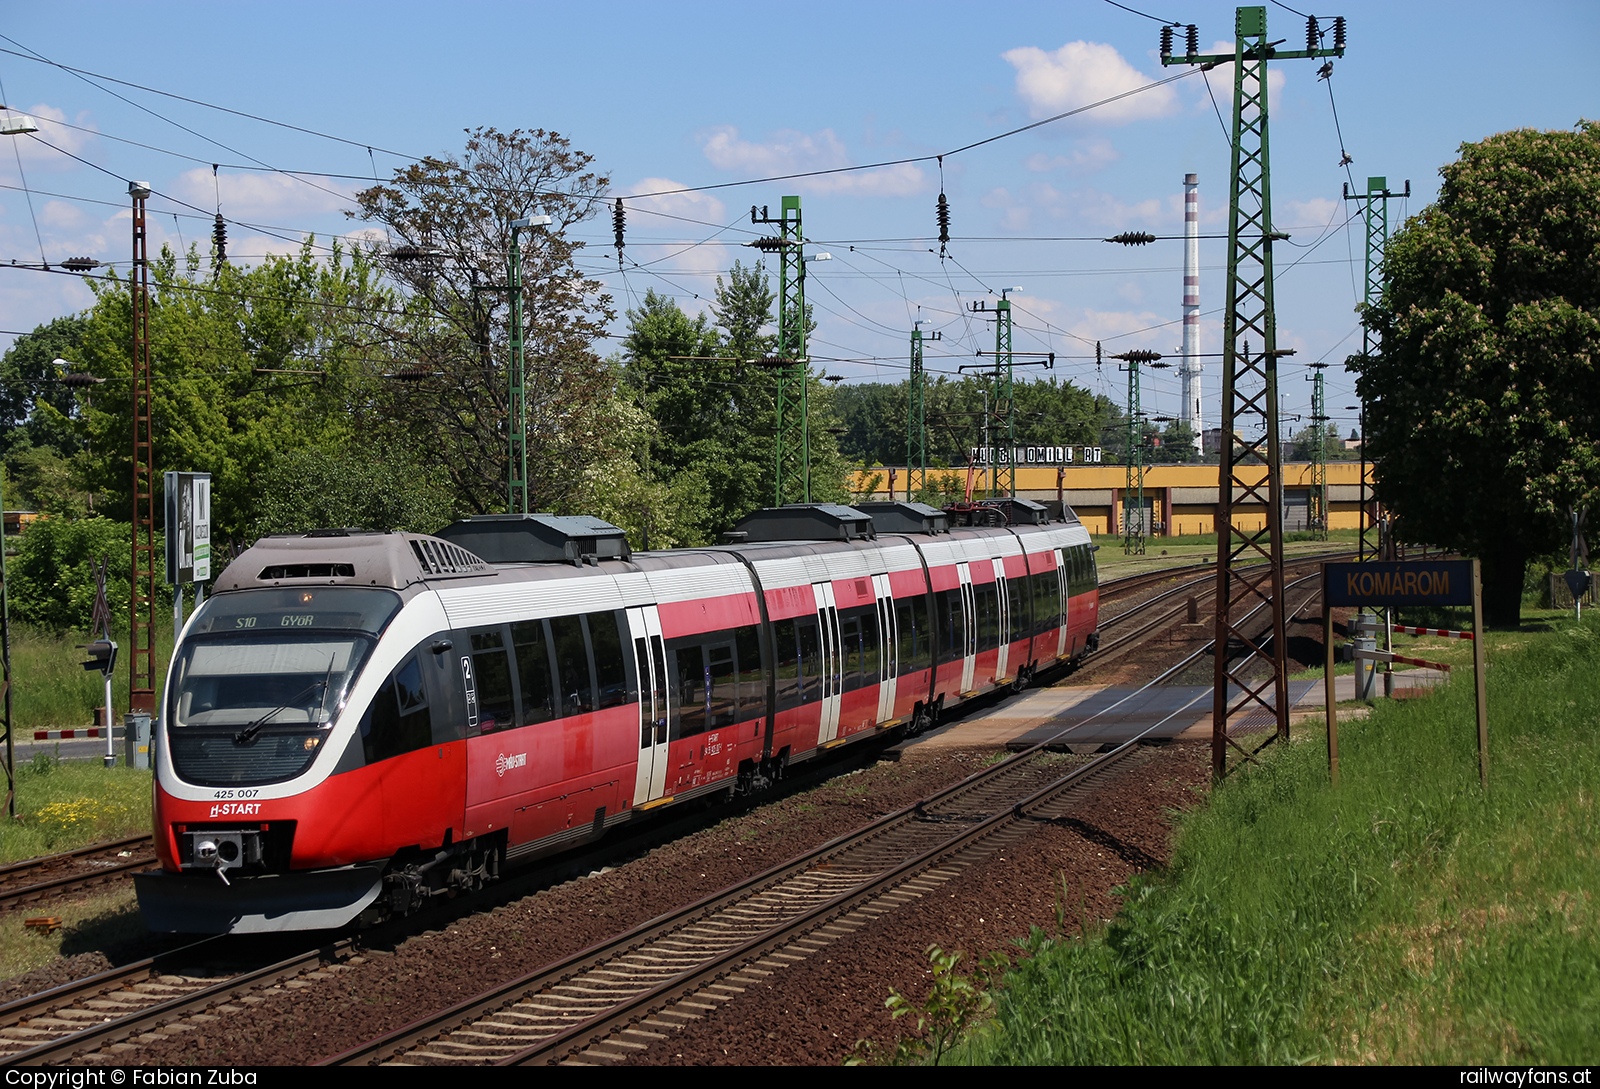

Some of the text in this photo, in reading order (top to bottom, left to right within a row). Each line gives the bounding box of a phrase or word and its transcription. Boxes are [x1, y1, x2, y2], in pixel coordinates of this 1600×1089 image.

[1084, 447, 1101, 462] RT
[1346, 566, 1450, 596] KOMÁROM
[235, 617, 257, 629] S10
[463, 659, 471, 679] 2
[213, 789, 259, 799] 425 007
